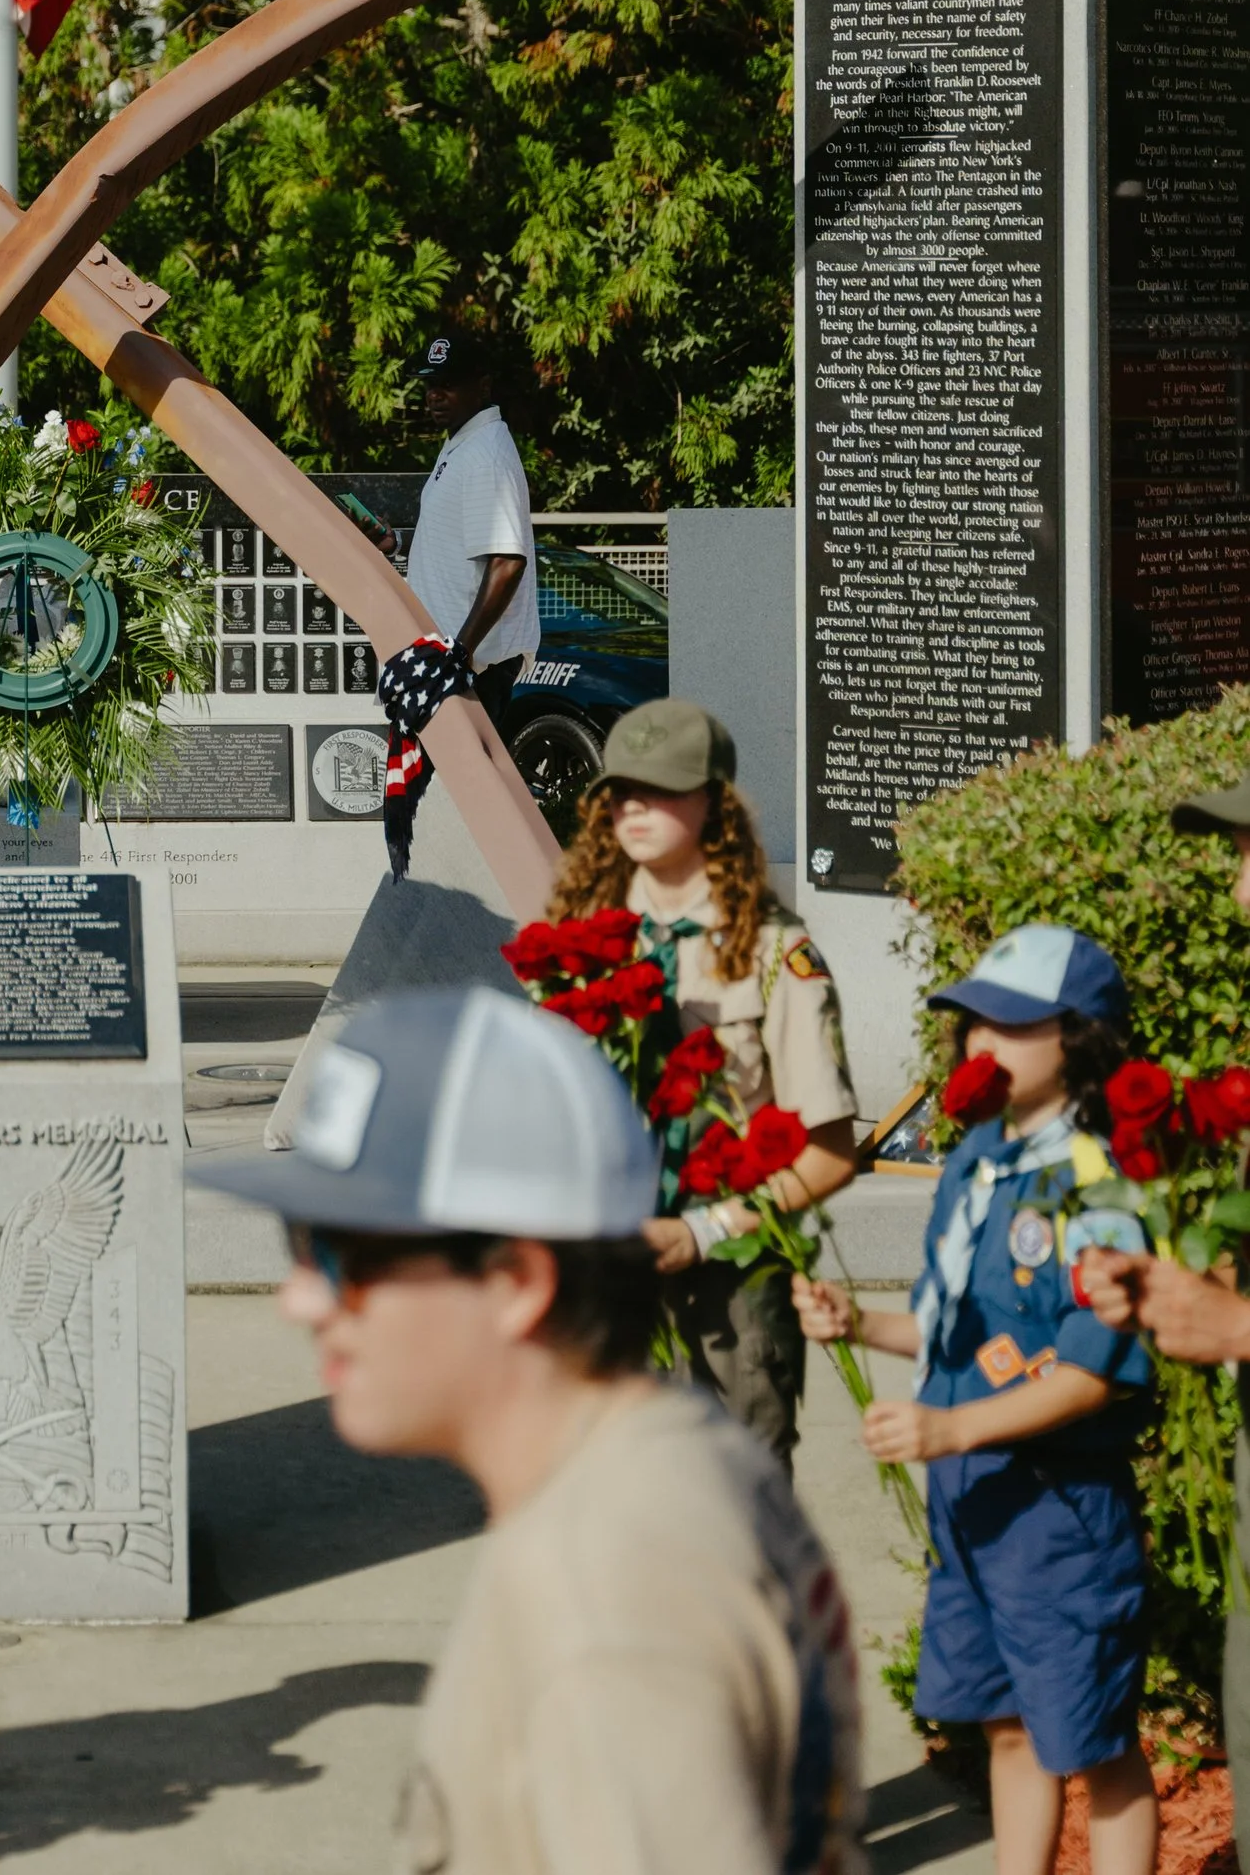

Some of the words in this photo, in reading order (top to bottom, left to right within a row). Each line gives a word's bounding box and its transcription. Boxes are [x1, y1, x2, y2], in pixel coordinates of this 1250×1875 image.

[833, 2, 861, 14] many
[830, 14, 857, 29] given
[860, 13, 884, 25] their
[887, 13, 909, 25] lives
[912, 12, 922, 24] in
[926, 12, 943, 24] the
[946, 14, 976, 23] name
[979, 11, 991, 22] of
[994, 10, 1026, 25] safety
[832, 29, 852, 40] and
[855, 28, 898, 43] security,
[901, 30, 952, 42] necessary
[956, 26, 971, 38] for
[974, 26, 1023, 38] freedom.
[815, 422, 839, 434] their
[841, 422, 866, 437] jobs,
[869, 423, 897, 434] these
[900, 426, 924, 435] men
[926, 423, 946, 435] and
[949, 427, 989, 436] women
[992, 424, 1042, 436] sacrificed
[827, 600, 852, 614] EMS,
[856, 604, 873, 613] our
[877, 603, 915, 618] military
[918, 604, 938, 616] and
[941, 605, 959, 617] law
[963, 607, 1030, 619] enforcement
[816, 659, 841, 671] crisis
[844, 660, 853, 672] is
[856, 663, 869, 672] an
[872, 665, 931, 674] uncommon
[934, 665, 968, 680] regard
[971, 666, 987, 678] for
[990, 668, 1043, 683] humanity.
[323, 734, 342, 751] FIRST
[343, 731, 388, 751] RESPONDERS
[1, 839, 27, 851] your
[4, 849, 27, 861] and
[128, 849, 156, 862] First
[163, 849, 237, 865] Responders
[31, 1125, 168, 1146] MEMORIAL
